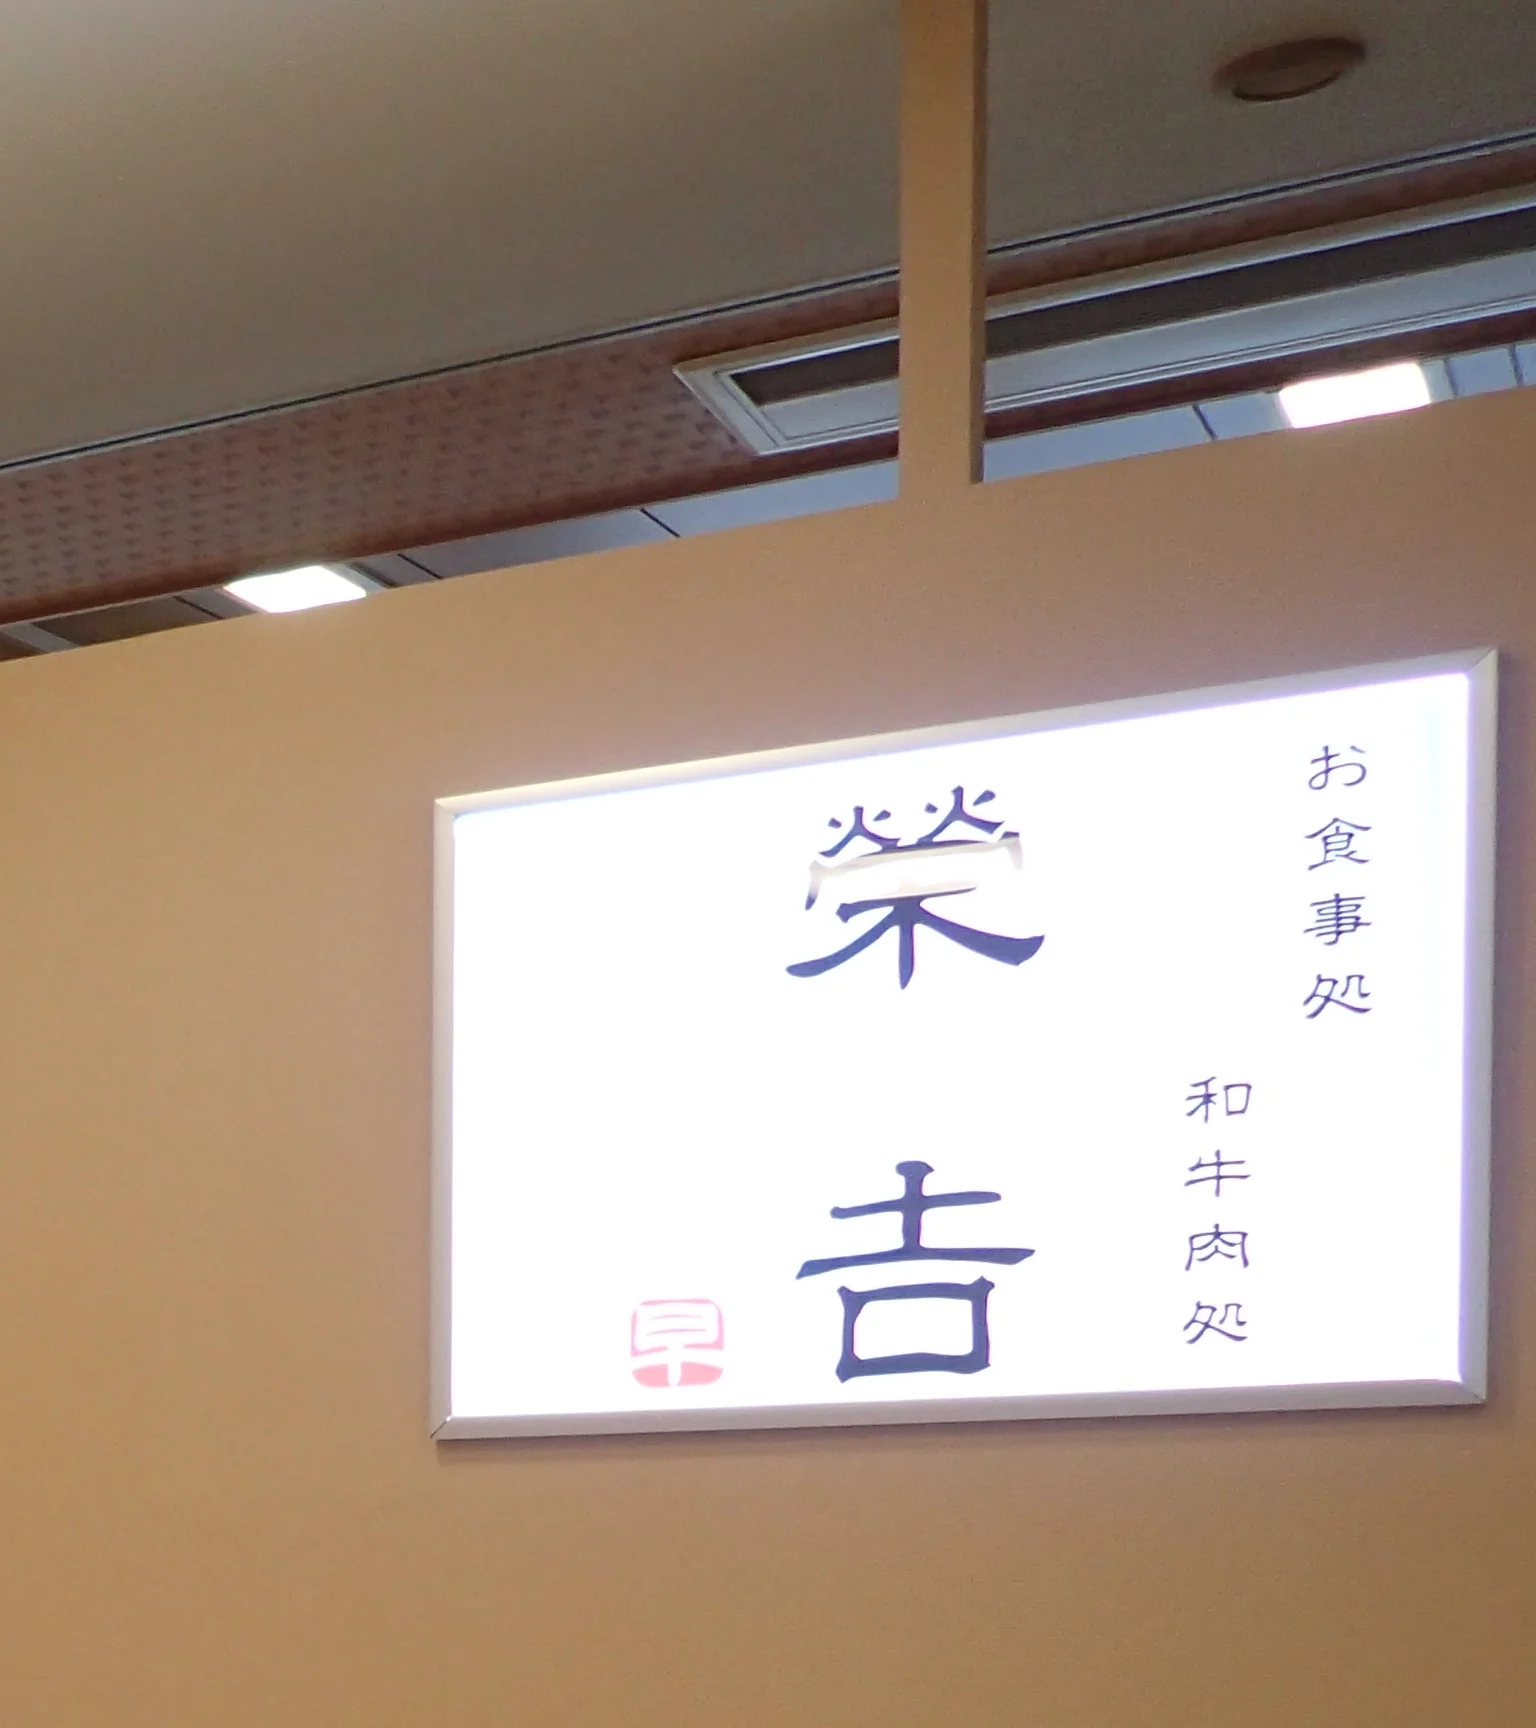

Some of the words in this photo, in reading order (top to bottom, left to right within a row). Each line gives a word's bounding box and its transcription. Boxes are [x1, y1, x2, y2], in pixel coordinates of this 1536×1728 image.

[1301, 744, 1373, 1020] お食事処
[1182, 1074, 1254, 1346] 和牛肉処
